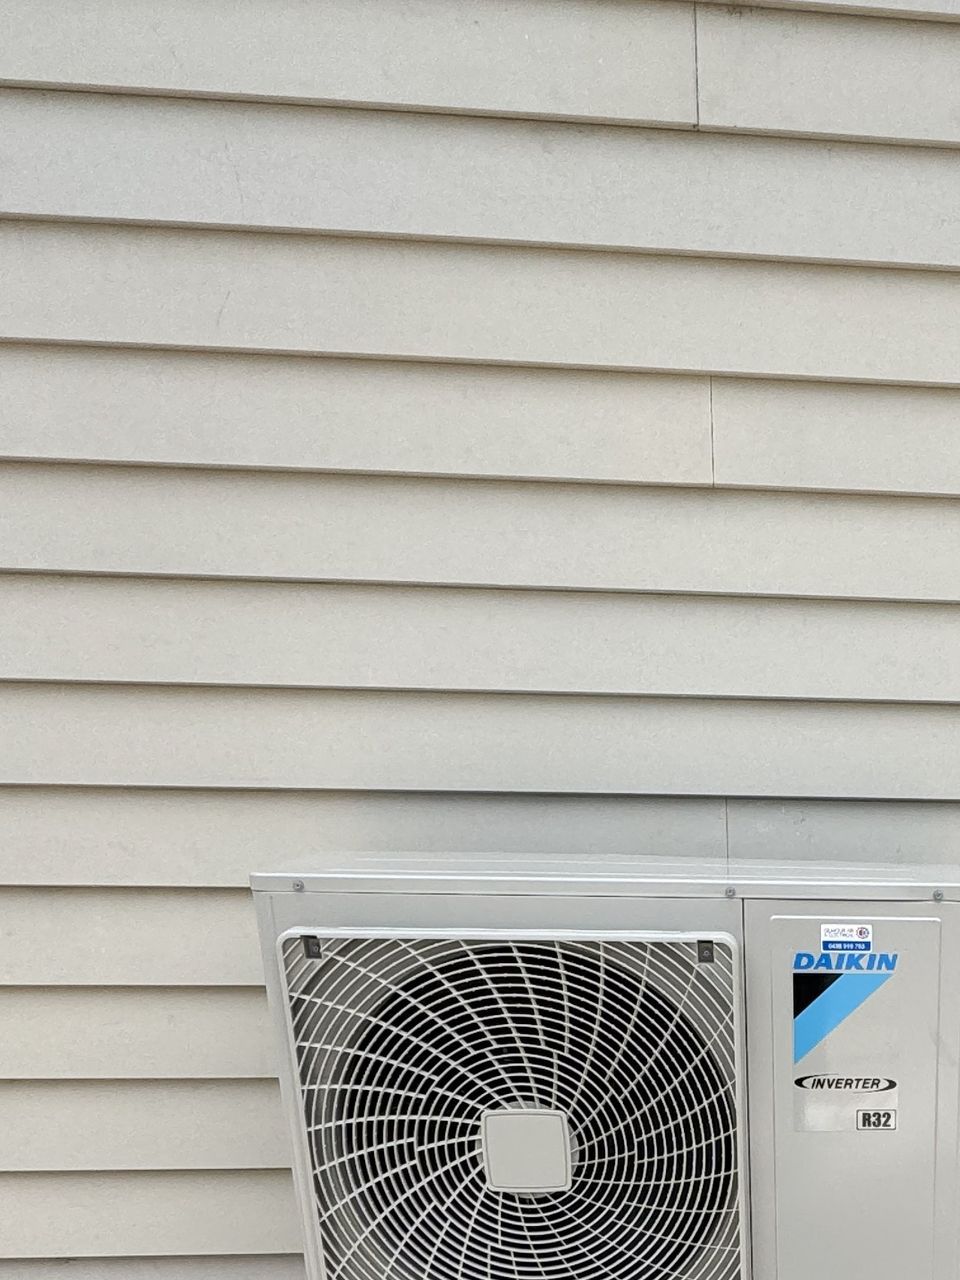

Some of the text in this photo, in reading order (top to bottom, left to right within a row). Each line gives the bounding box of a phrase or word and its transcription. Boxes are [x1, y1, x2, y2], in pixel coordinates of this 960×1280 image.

[793, 953, 898, 971] DAIKIN
[811, 1078, 881, 1090] INVERTER
[862, 1112, 891, 1128] R32
